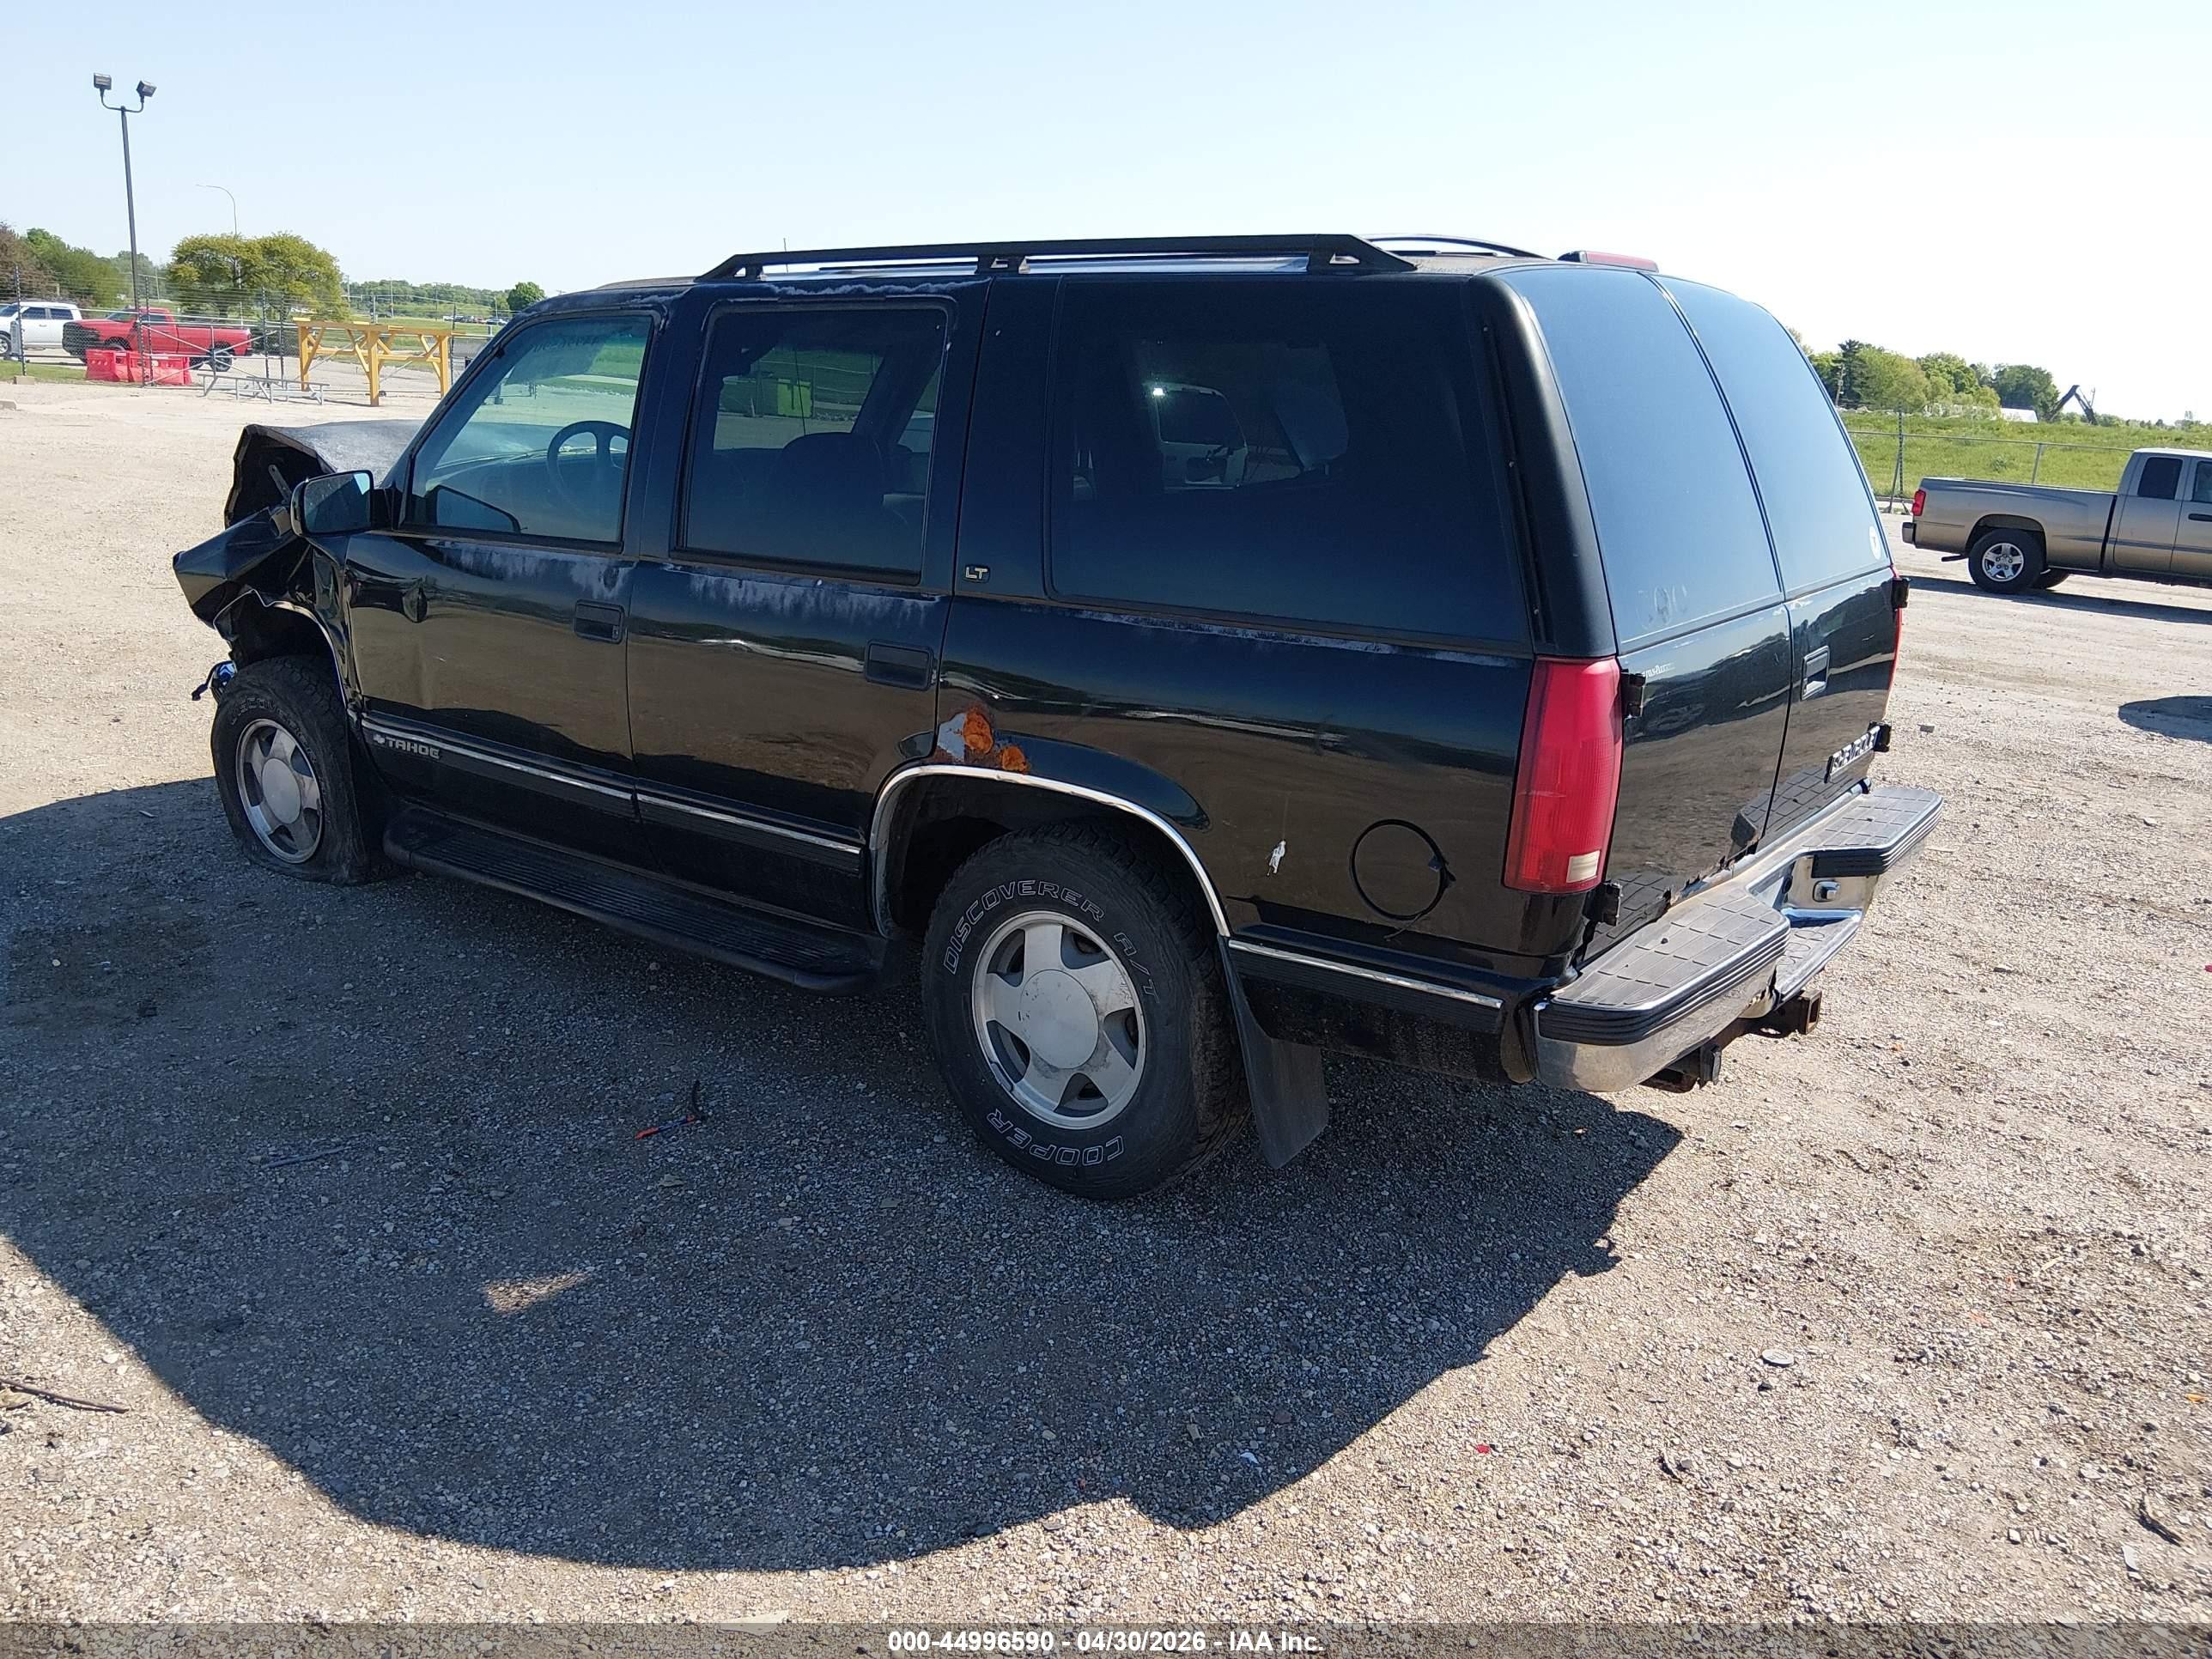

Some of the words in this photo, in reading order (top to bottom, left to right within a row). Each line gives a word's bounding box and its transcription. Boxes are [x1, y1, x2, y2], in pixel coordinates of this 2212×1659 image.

[965, 566, 989, 580] LT
[386, 736, 441, 760] TAHOE
[944, 879, 1105, 975] DISCOVERER
[1113, 932, 1160, 1004] A/T
[987, 1108, 1124, 1166] COOPER
